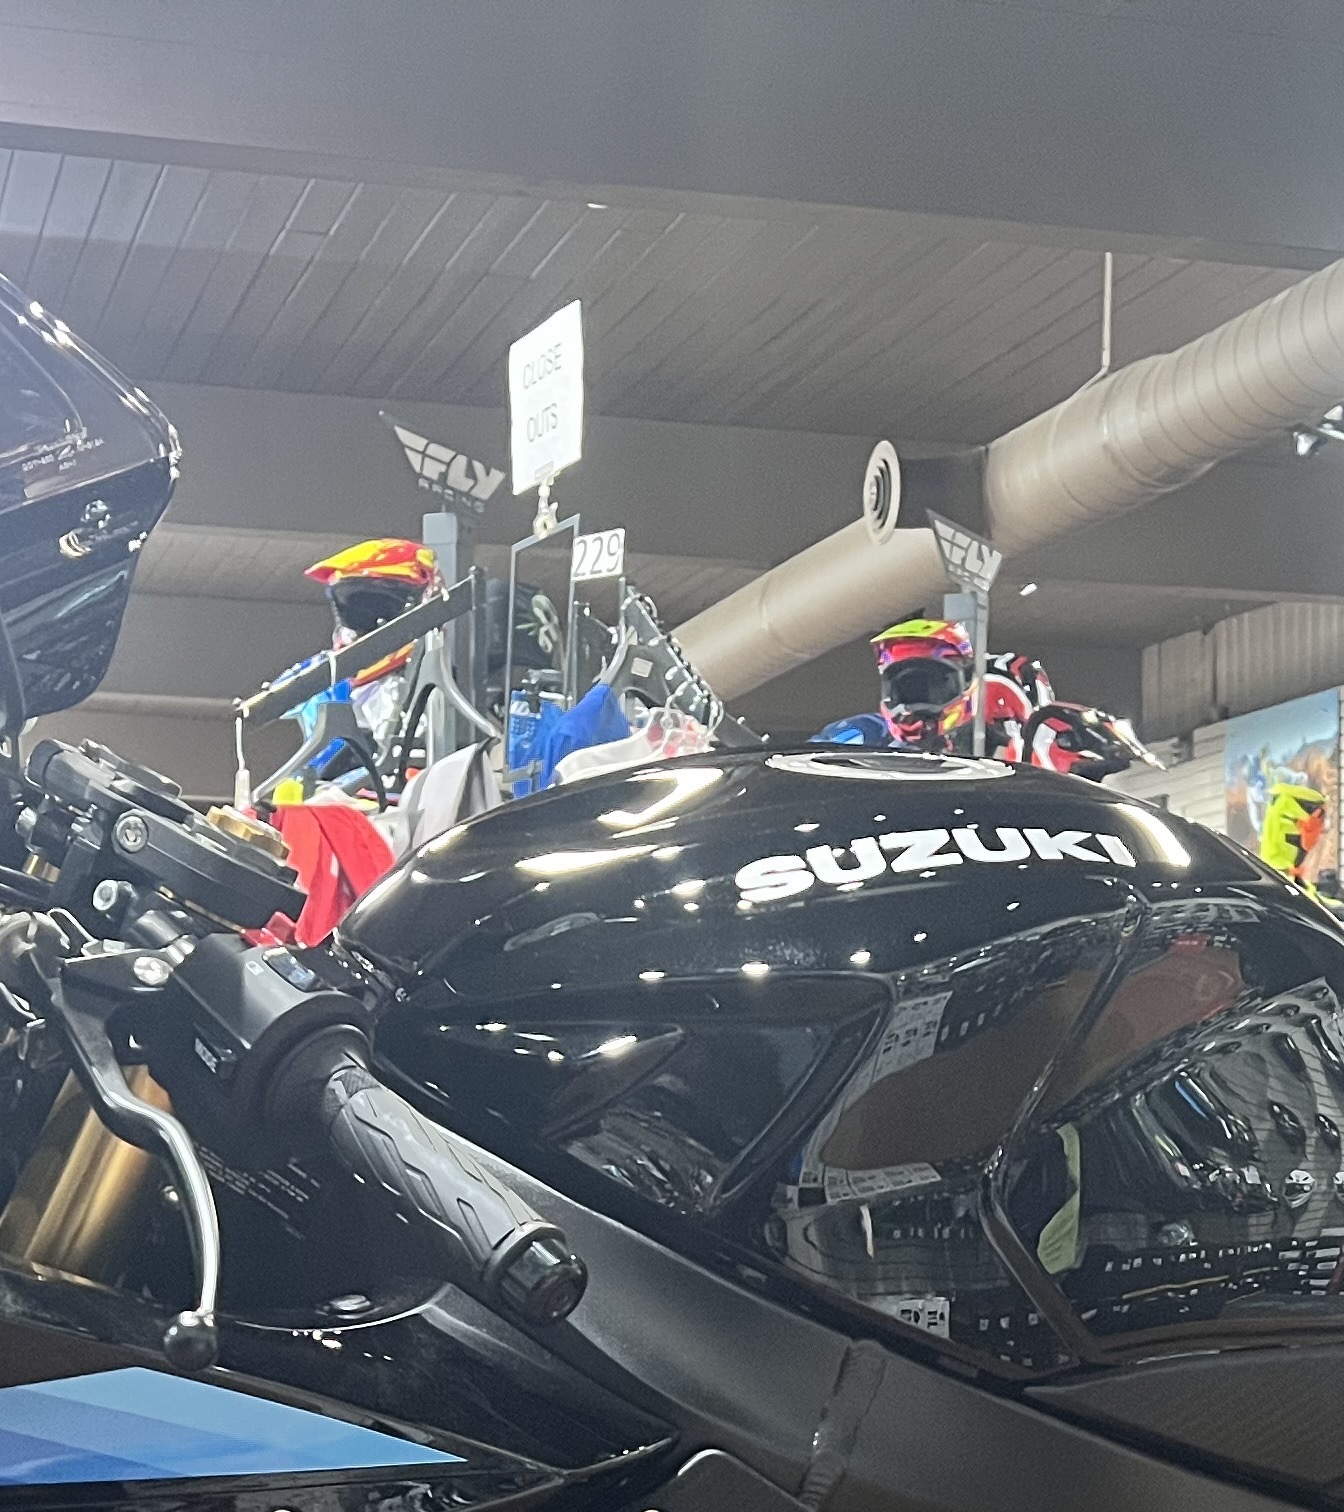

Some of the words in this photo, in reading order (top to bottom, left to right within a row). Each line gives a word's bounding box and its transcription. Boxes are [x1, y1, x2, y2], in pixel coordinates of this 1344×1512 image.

[523, 342, 562, 389] CLOSE
[527, 402, 559, 443] OUTS
[394, 425, 505, 500] FLY
[573, 533, 621, 577] 229
[735, 827, 1137, 902] SUZUKI
